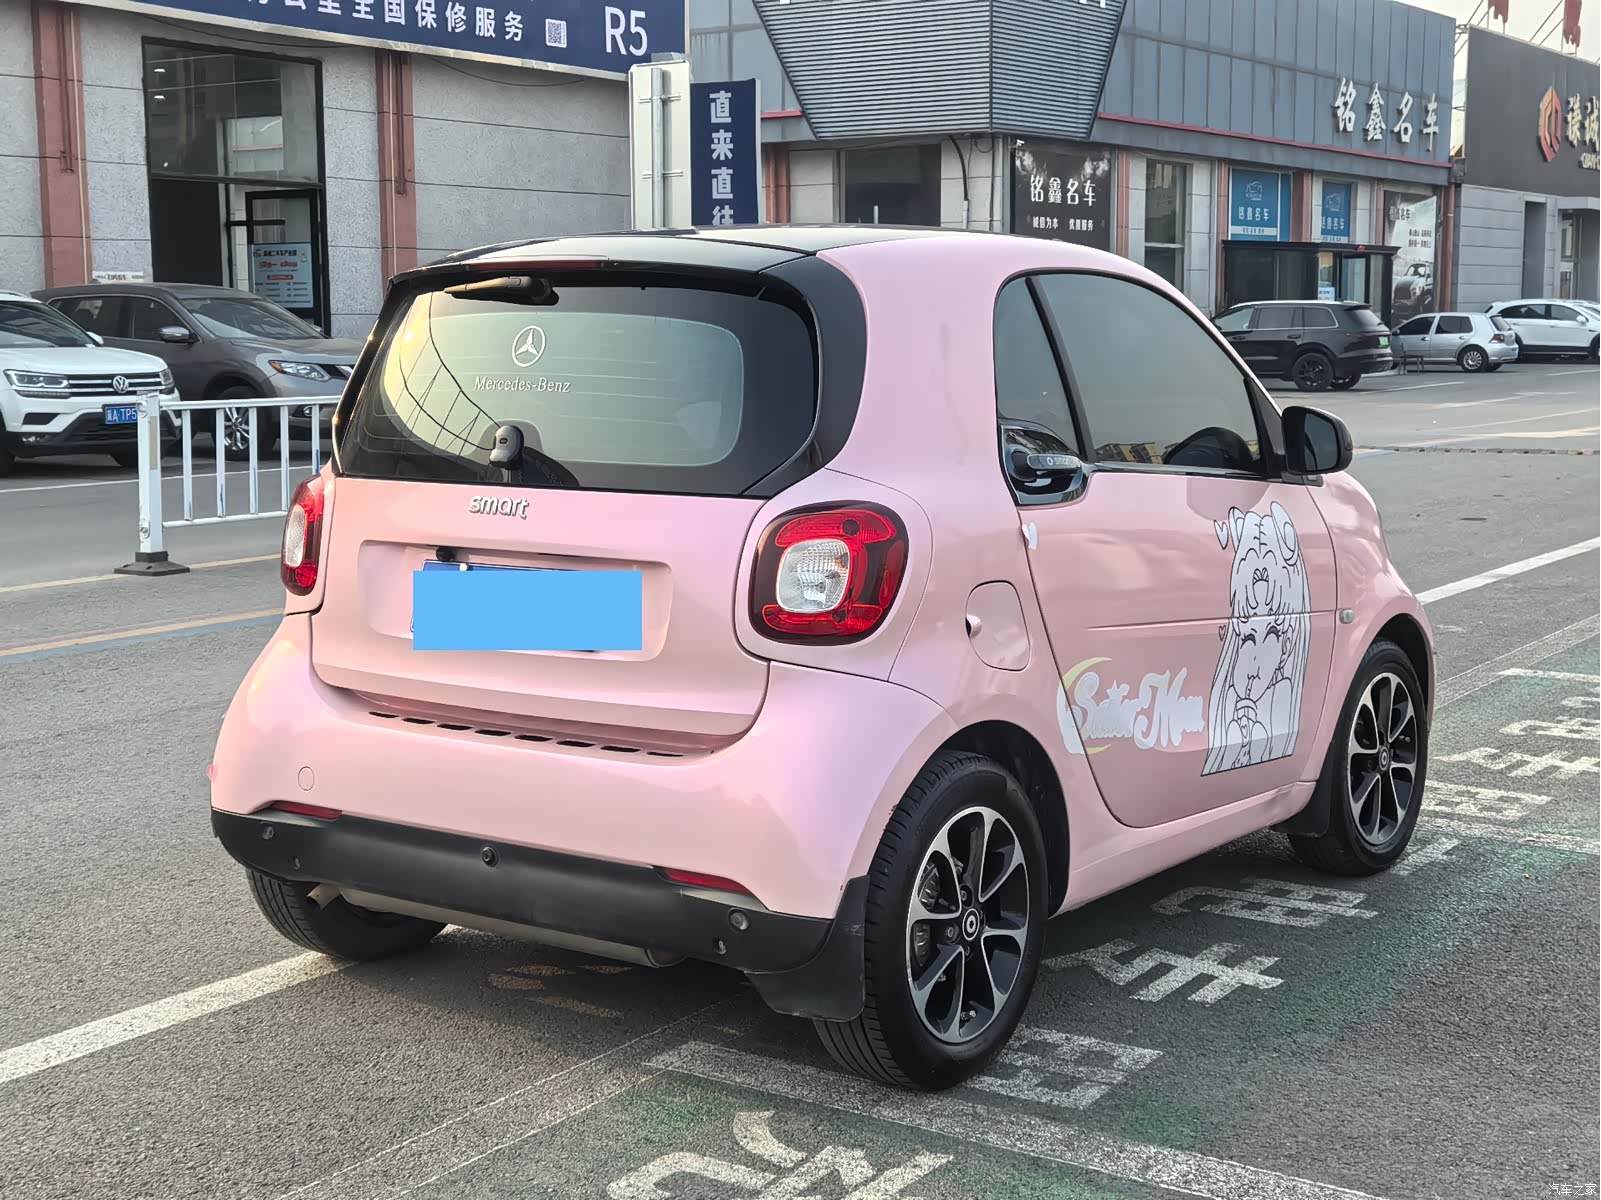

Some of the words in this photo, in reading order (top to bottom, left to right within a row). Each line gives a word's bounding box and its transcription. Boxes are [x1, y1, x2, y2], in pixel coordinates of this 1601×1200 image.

[248, 0, 524, 42] 里全国保修服务
[604, 5, 649, 57] R5
[1334, 77, 1440, 152] 铭鑫名车
[1030, 174, 1097, 207] 铭鑫名车
[474, 376, 571, 392] Mercedes-Benz
[469, 494, 530, 519] smart
